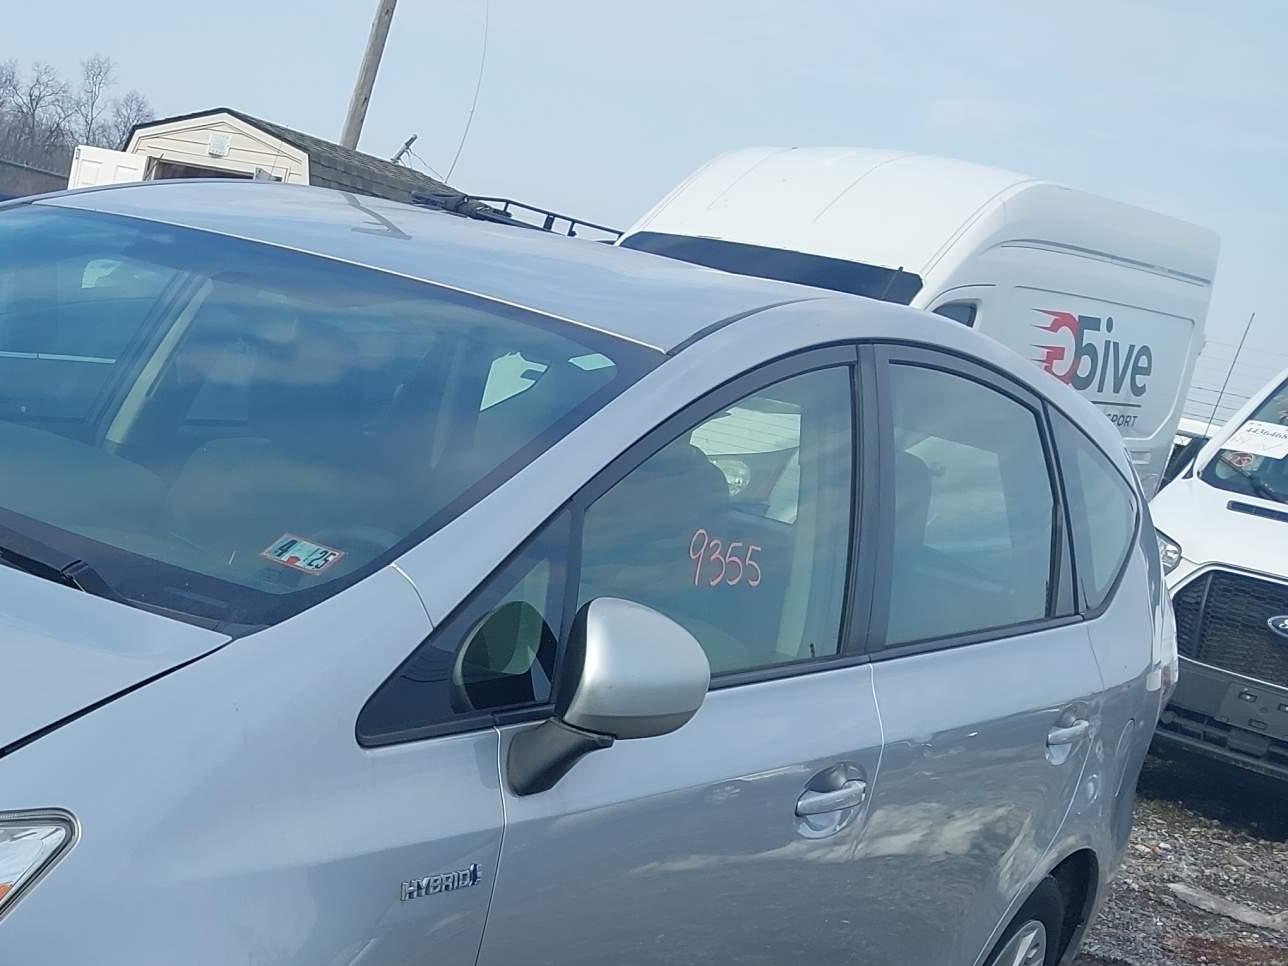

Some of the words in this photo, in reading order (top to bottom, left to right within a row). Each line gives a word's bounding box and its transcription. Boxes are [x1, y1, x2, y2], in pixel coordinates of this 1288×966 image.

[1106, 413, 1139, 428] PORT
[689, 528, 761, 587] 9355
[400, 869, 471, 901] HYBRID
